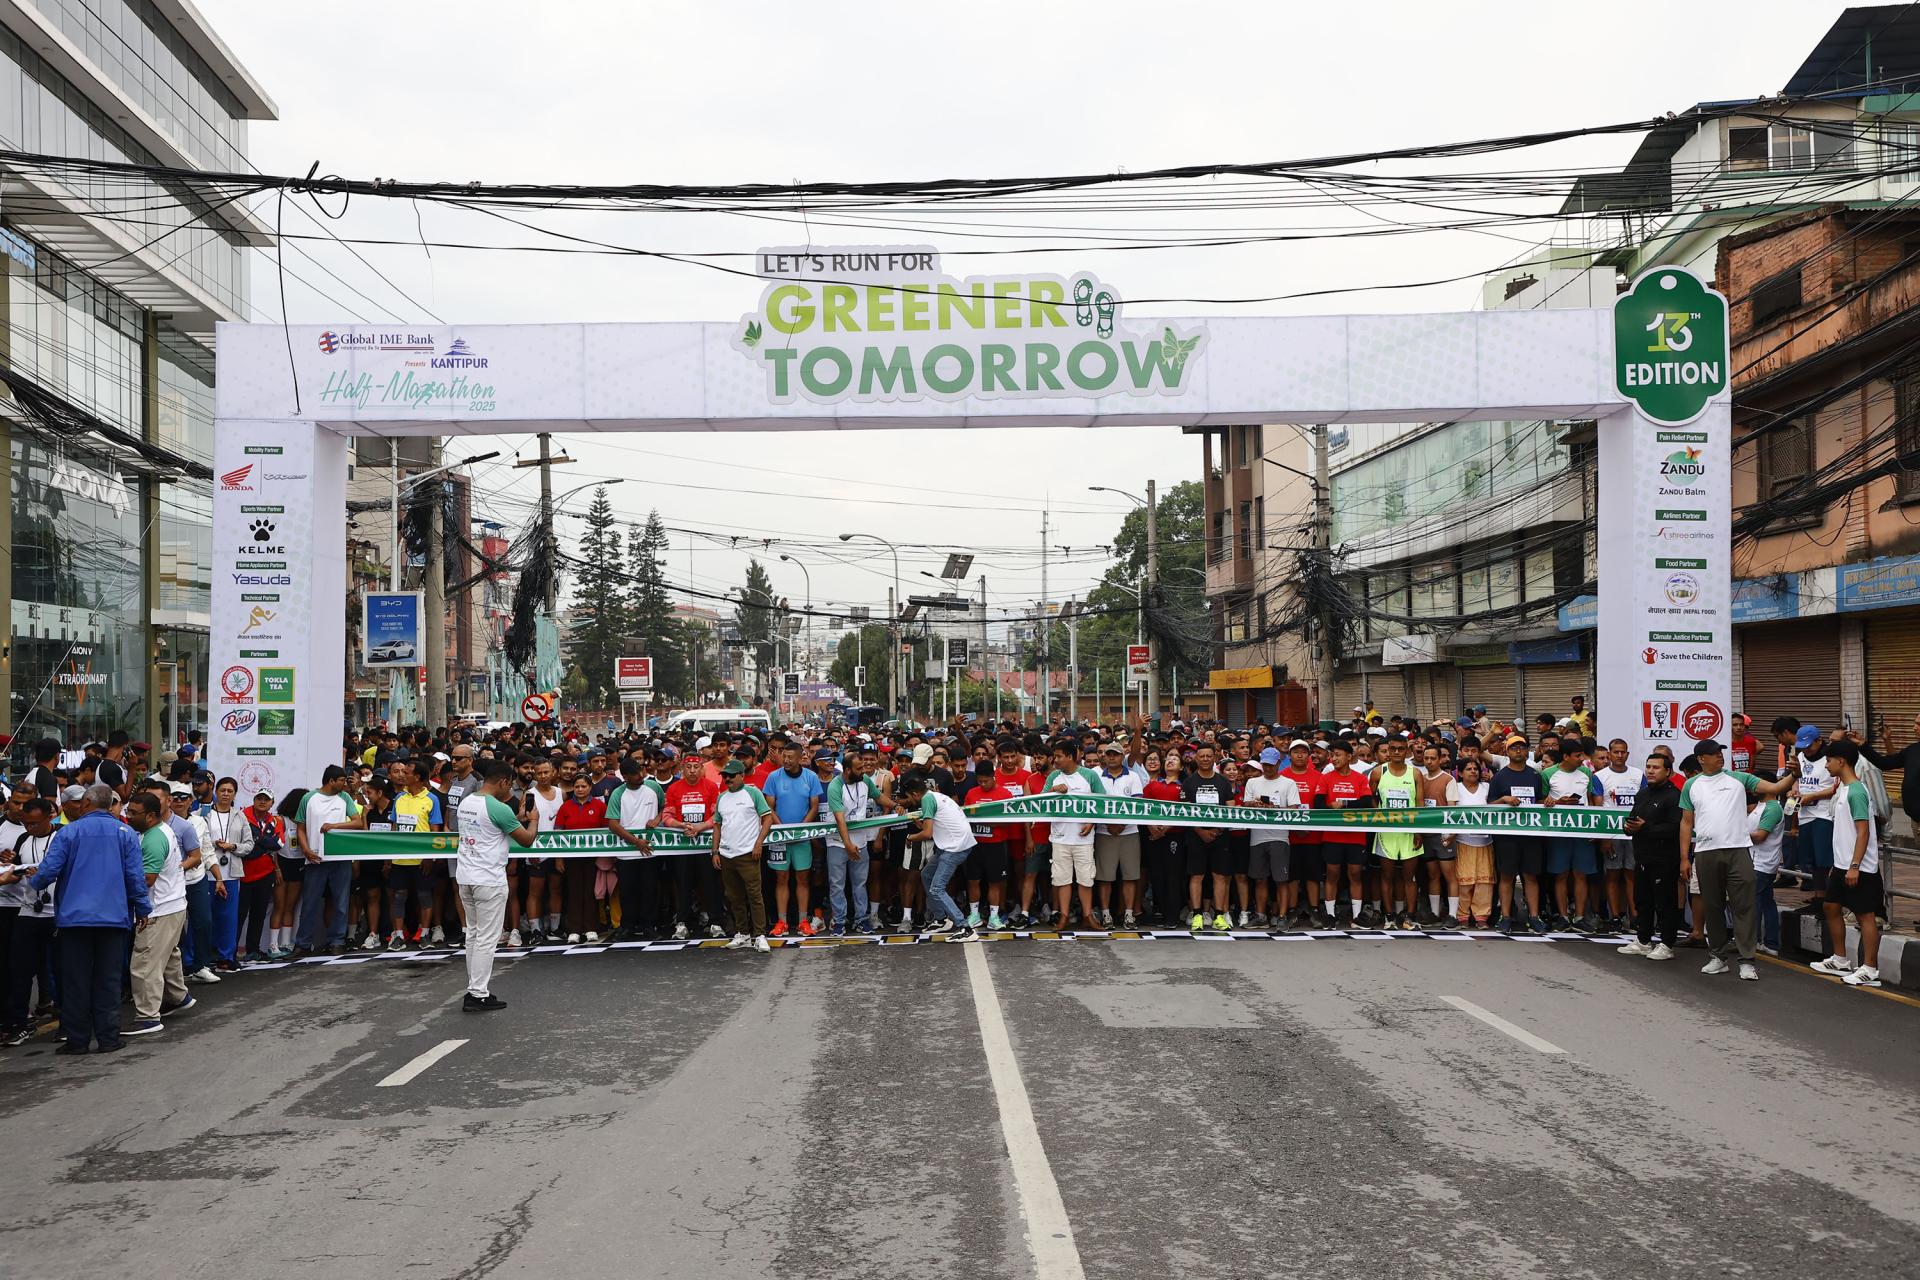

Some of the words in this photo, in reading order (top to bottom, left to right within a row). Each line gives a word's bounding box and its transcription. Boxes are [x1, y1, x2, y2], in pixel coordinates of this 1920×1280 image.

[763, 254, 825, 273] LET'S
[832, 253, 881, 271] RUN
[888, 252, 933, 271] FOR
[765, 281, 1069, 334] GREENER
[340, 333, 375, 344] Global
[380, 334, 402, 344] IME
[407, 333, 434, 344] Bank
[431, 358, 488, 369] KANTIPUR
[764, 341, 1187, 397] TOMORROW
[1625, 361, 1719, 386] EDITION
[469, 401, 496, 412] 2025
[1687, 434, 1704, 442] Partner
[1660, 462, 1704, 475] ZANDU
[1685, 488, 1706, 496] Balm
[238, 546, 285, 554] KELME
[1679, 560, 1698, 568] Partner
[231, 573, 291, 585] Yasuda
[1652, 633, 1672, 641] Climate
[1692, 634, 1710, 642] Partner
[1661, 652, 1678, 660] Save
[1692, 653, 1722, 661] Children
[1658, 681, 1687, 689] Celebration
[1688, 682, 1706, 690] Partner
[225, 711, 252, 731] Real
[1690, 717, 1714, 728] Pizza
[1649, 729, 1672, 738] KFC
[1694, 725, 1711, 734] Hut
[1389, 800, 1407, 808] 1964
[1620, 796, 1635, 805] 284
[684, 814, 703, 822] 3080
[1002, 800, 1097, 815] KANTIPUR
[1104, 800, 1154, 817] HALF
[1160, 804, 1268, 822] MARATHON
[1274, 811, 1311, 823] 2025
[1343, 811, 1418, 825] START
[1442, 811, 1542, 828] KANTIPUR
[1549, 813, 1600, 829] HALF
[532, 833, 628, 850] KANTIPUR
